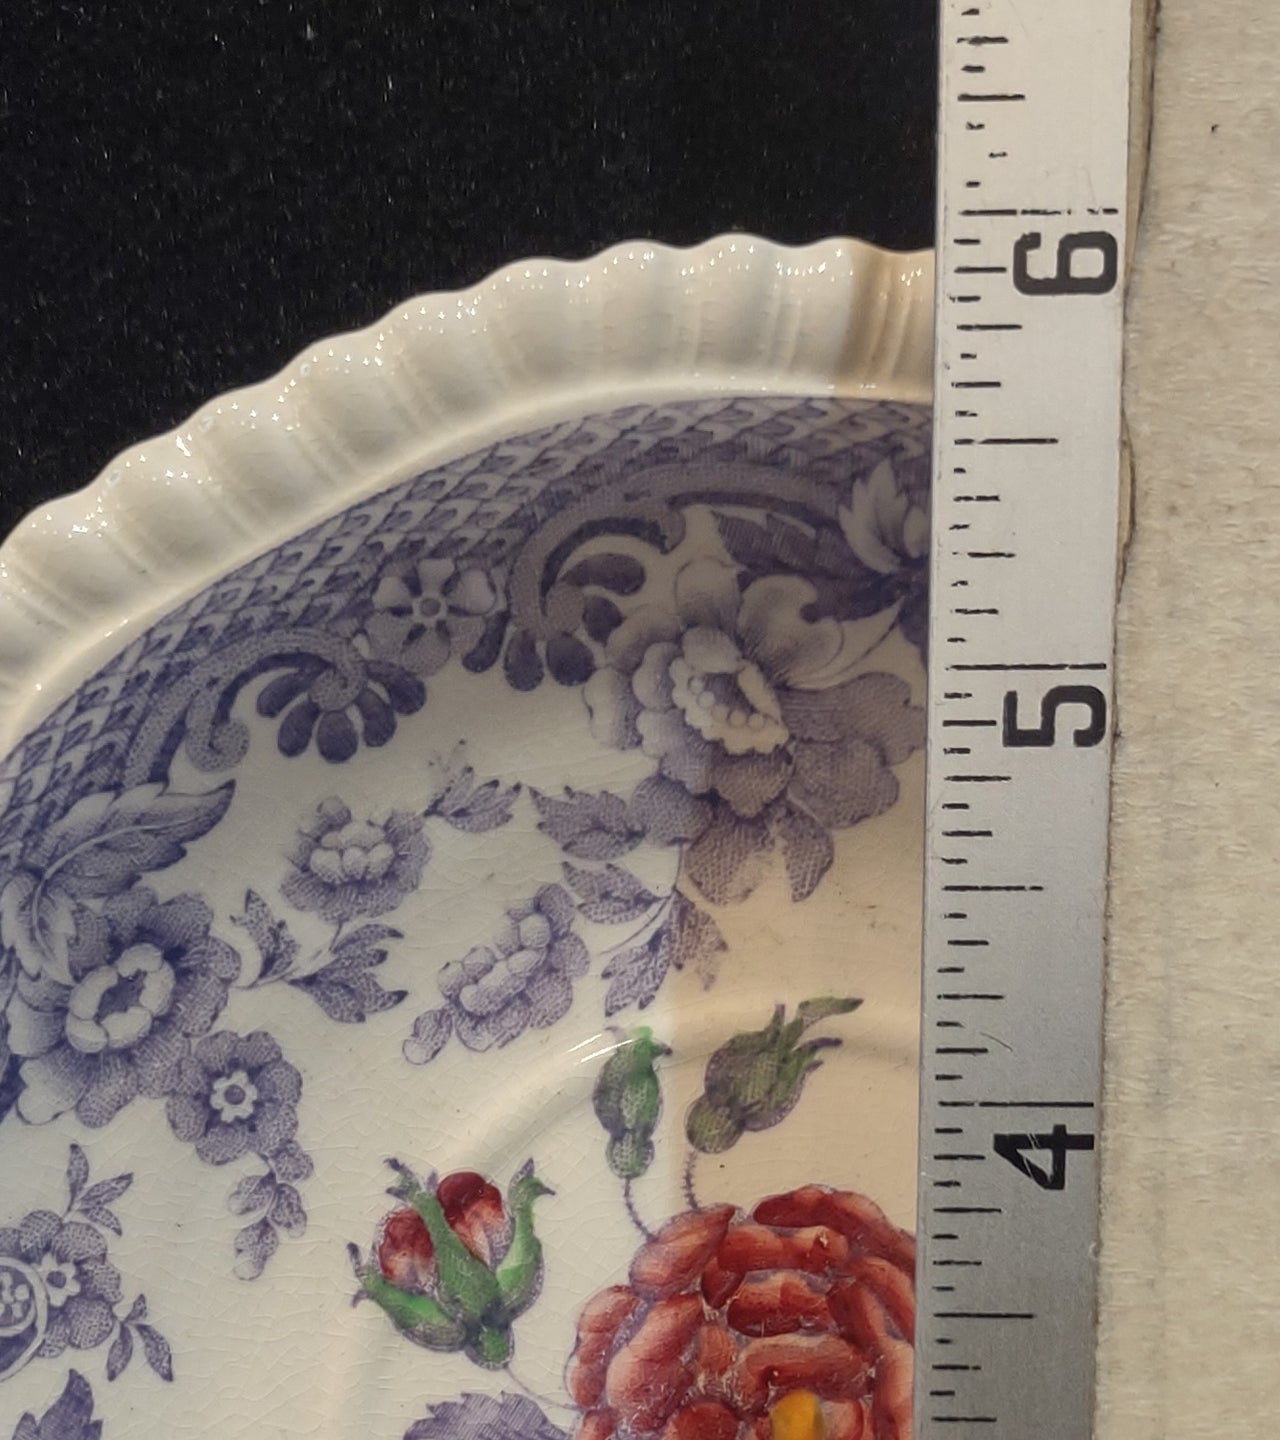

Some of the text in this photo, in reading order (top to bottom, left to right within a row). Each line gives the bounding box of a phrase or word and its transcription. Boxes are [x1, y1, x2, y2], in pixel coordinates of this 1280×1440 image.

[1013, 231, 1118, 296] 6
[1002, 685, 1107, 748] 5
[993, 1124, 1095, 1190] 4
